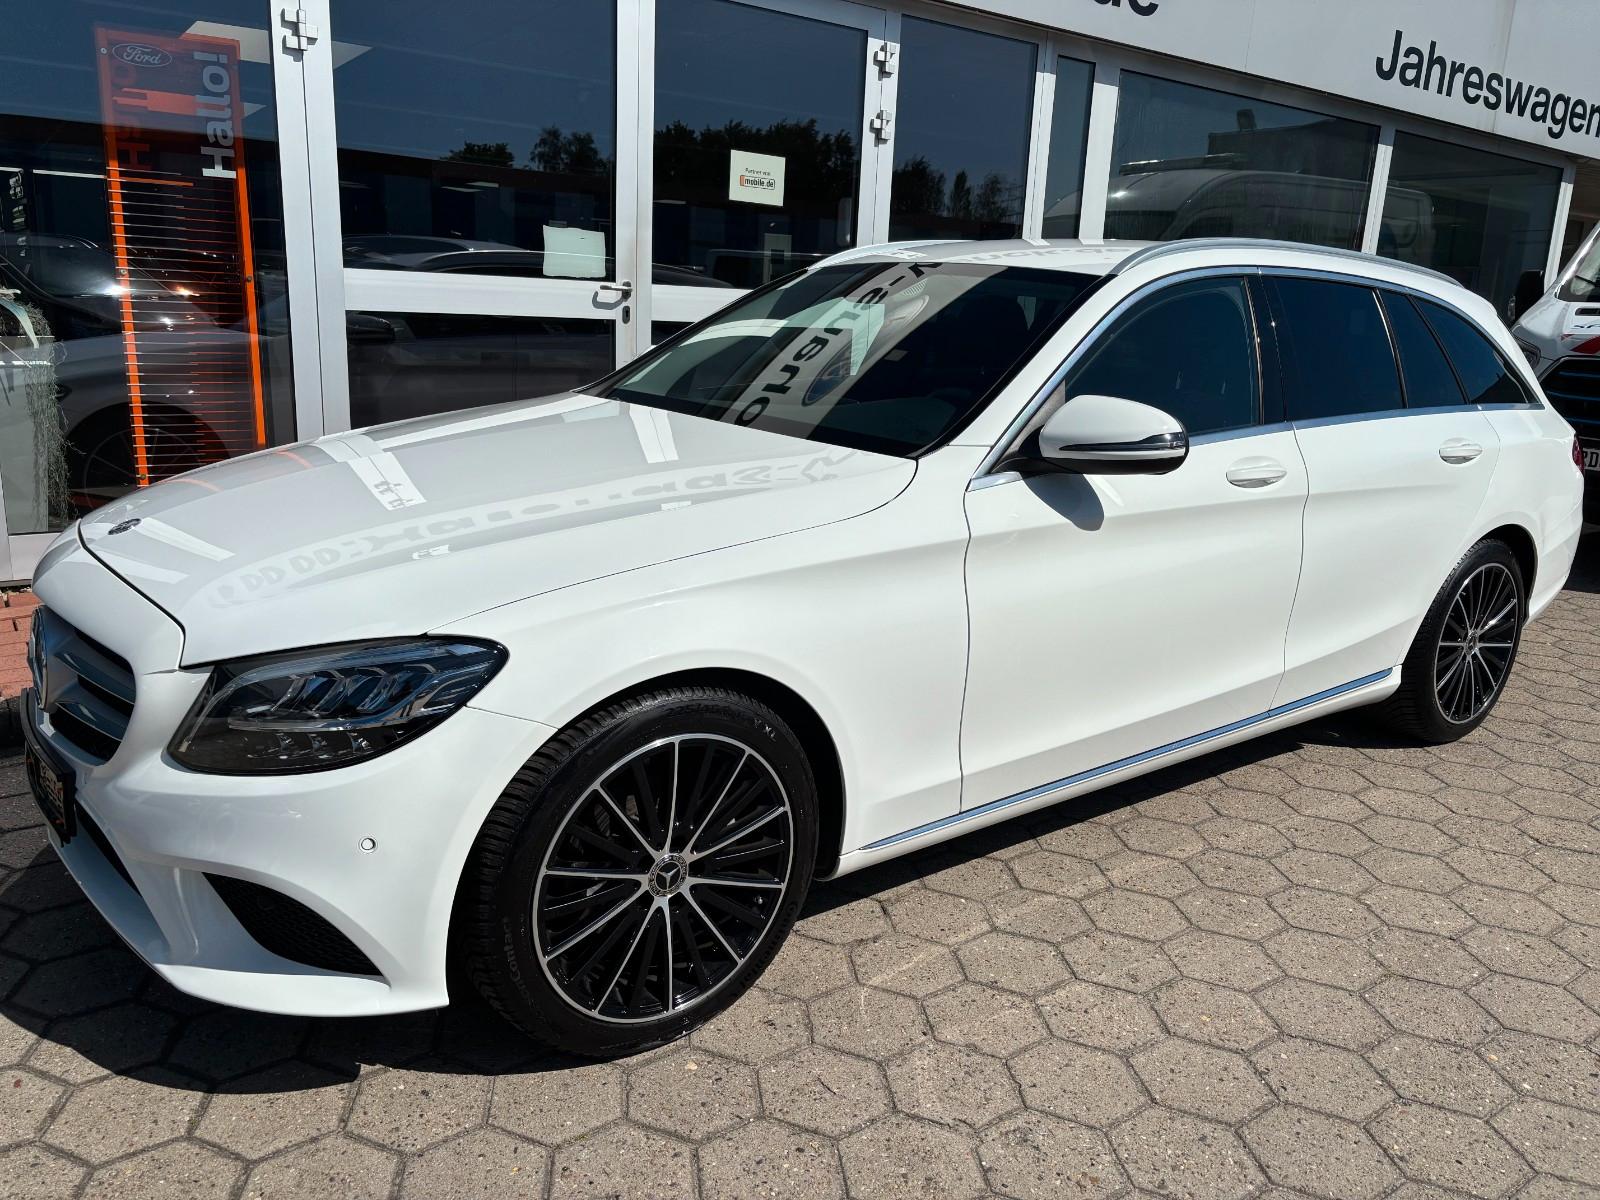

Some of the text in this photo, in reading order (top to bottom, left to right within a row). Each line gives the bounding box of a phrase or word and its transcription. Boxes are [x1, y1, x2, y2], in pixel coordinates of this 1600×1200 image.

[123, 45, 161, 65] Ford
[1376, 29, 1600, 139] Jahreswagen
[193, 51, 237, 179] Hallo!
[744, 178, 774, 188] mobile.de
